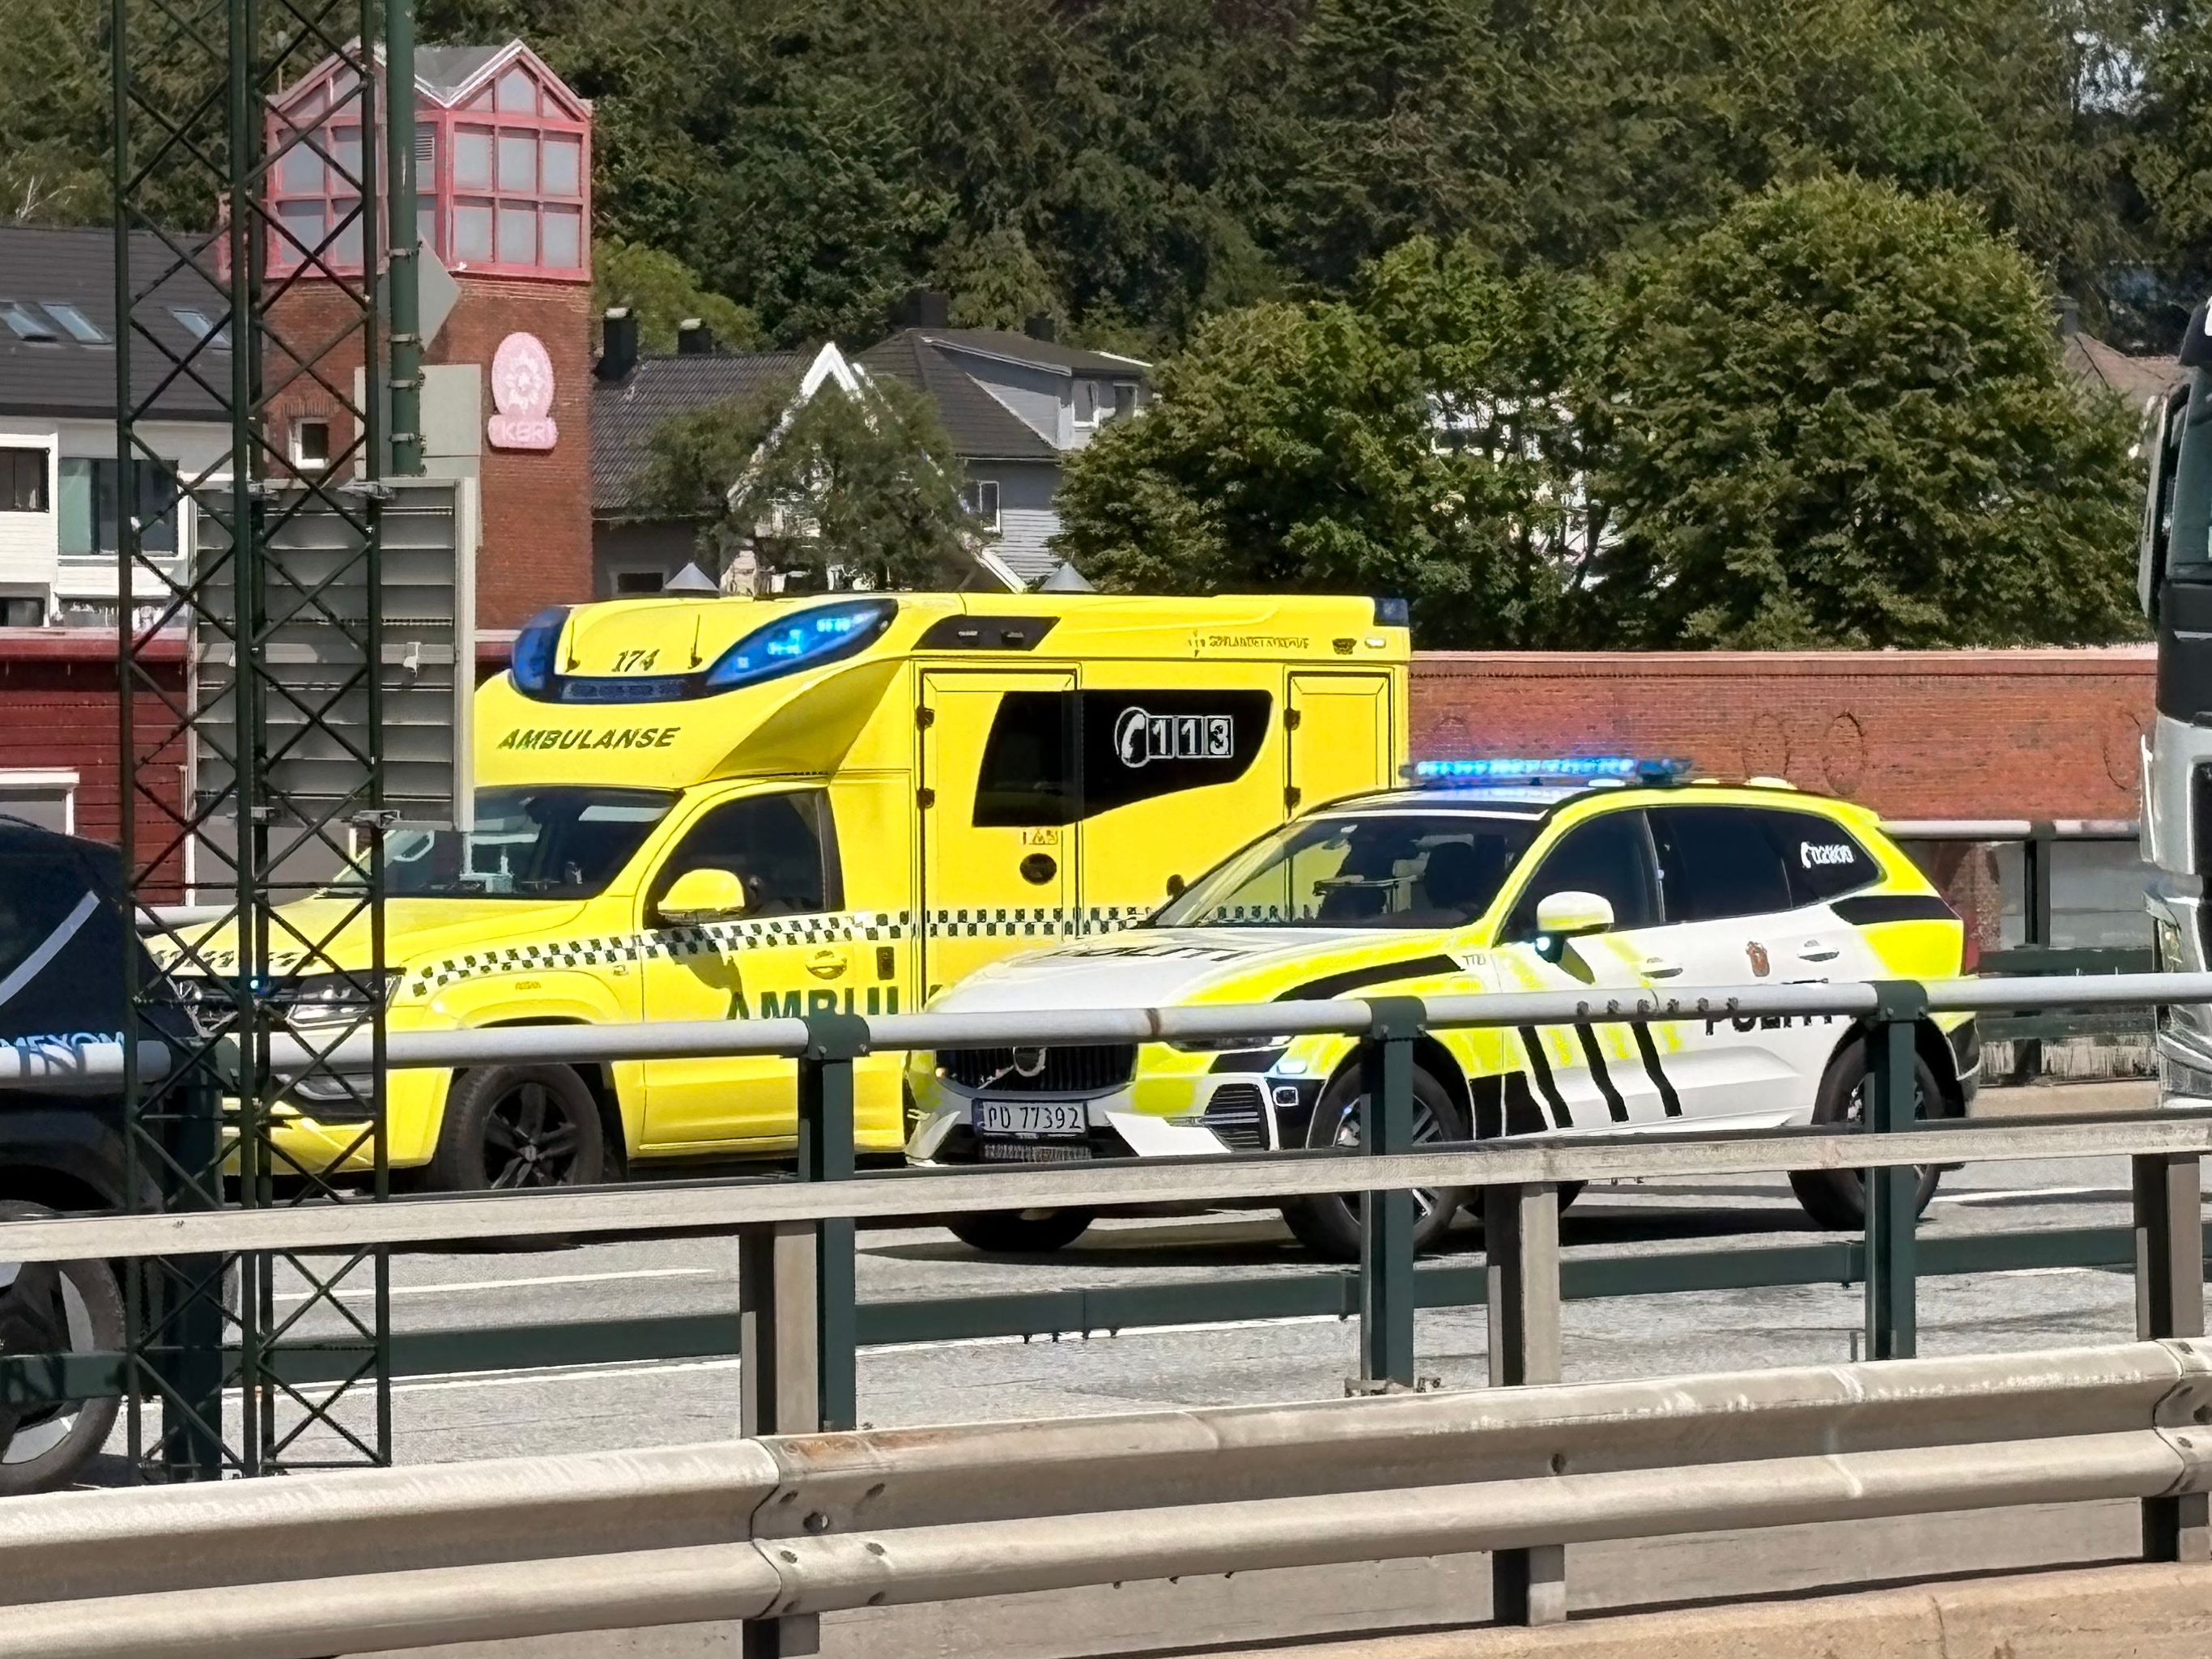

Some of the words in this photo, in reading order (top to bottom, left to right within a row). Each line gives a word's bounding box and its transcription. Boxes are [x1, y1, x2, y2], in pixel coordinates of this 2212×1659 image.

[611, 649, 660, 672] 174
[496, 727, 681, 750] AMBULANSE
[1151, 718, 1231, 755] 113
[989, 1106, 1011, 1129] PD
[1019, 1106, 1082, 1129] 77392
